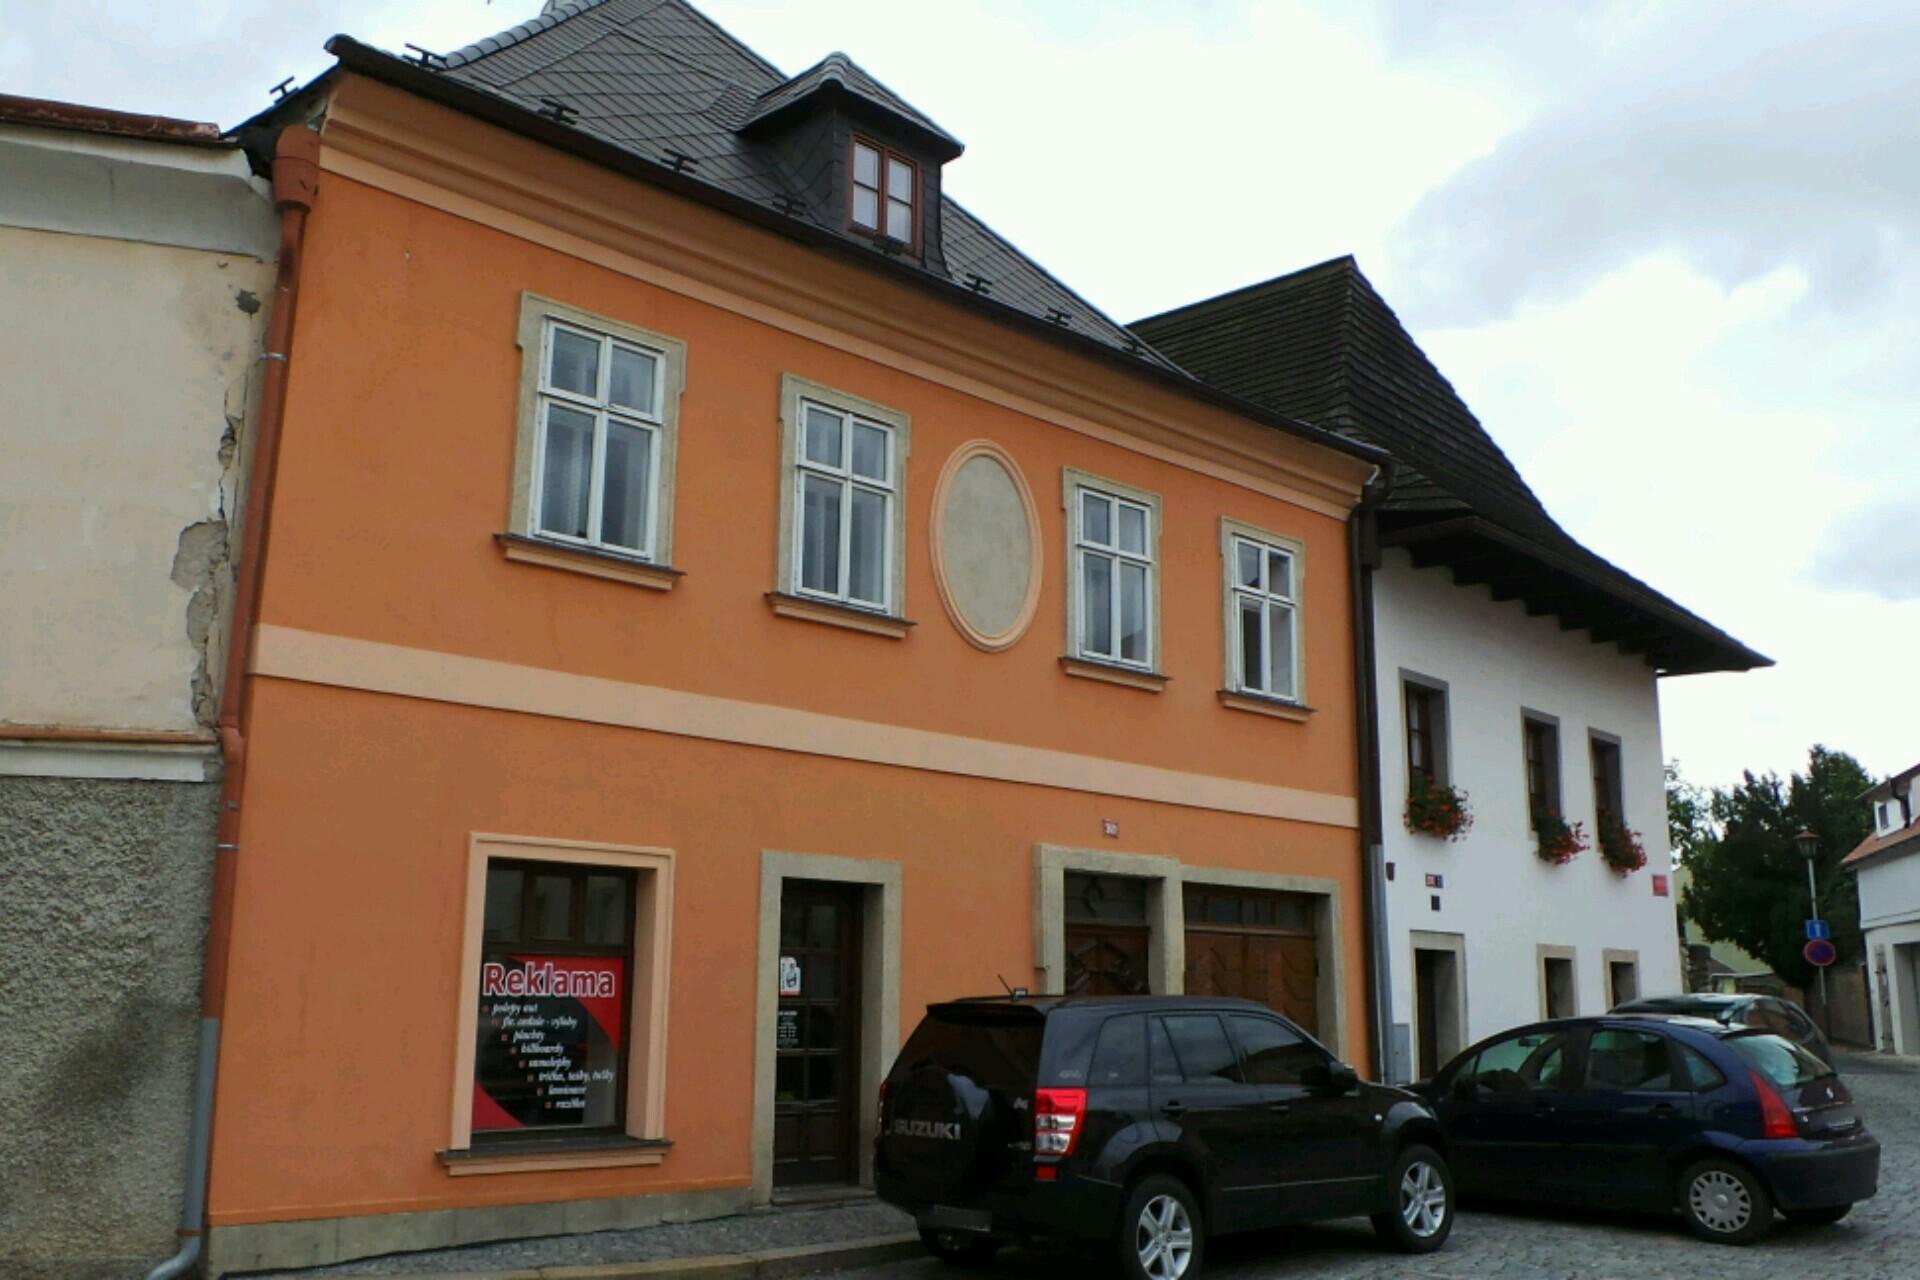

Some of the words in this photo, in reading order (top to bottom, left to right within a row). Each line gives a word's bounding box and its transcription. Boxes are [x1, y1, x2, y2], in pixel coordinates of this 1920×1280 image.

[483, 962, 615, 998] Reklama
[513, 1029, 545, 1044] plachty
[529, 1056, 572, 1070] samolepky
[895, 1119, 961, 1139] SUZUKI
